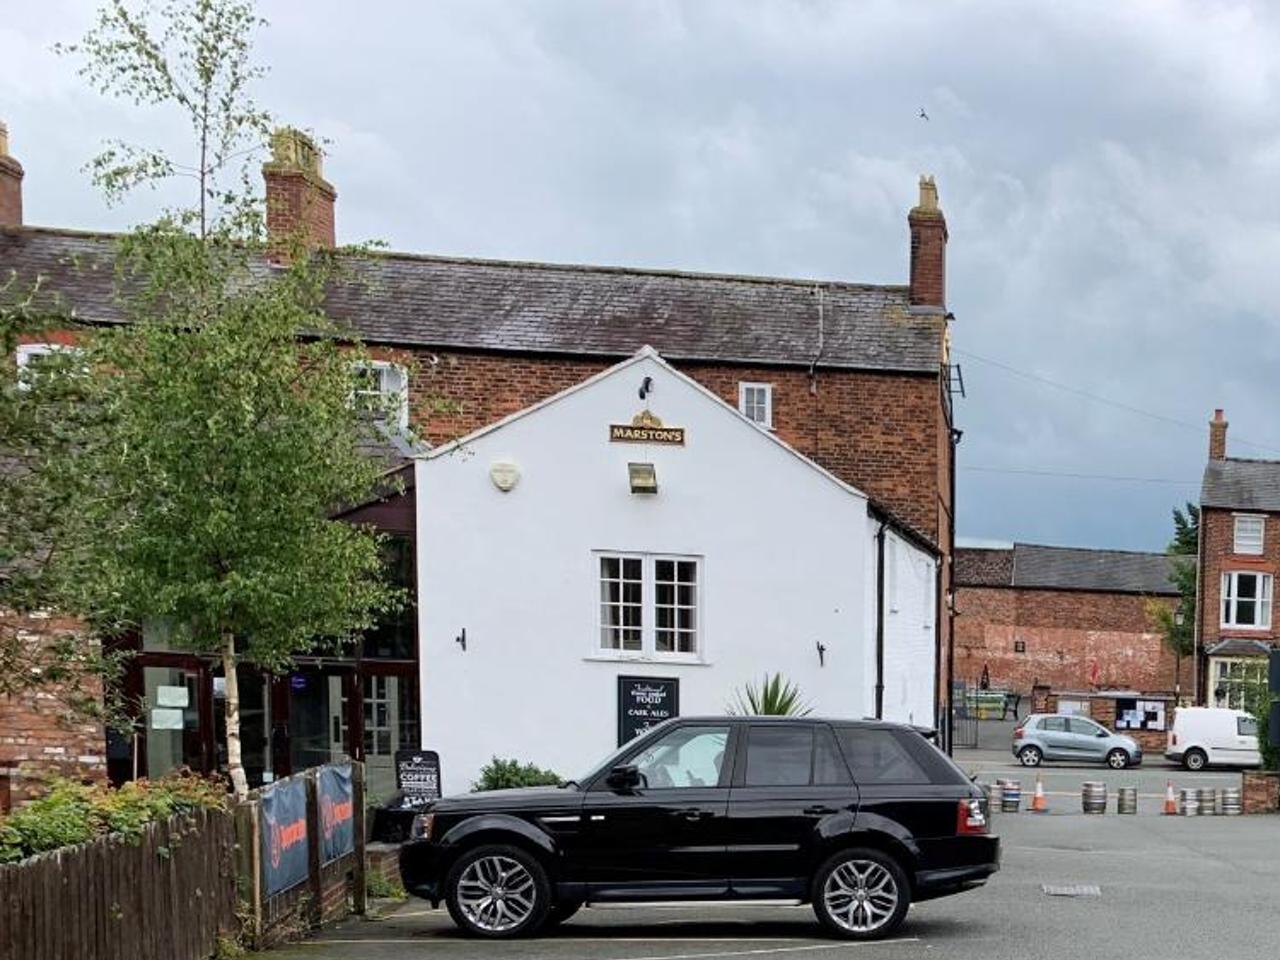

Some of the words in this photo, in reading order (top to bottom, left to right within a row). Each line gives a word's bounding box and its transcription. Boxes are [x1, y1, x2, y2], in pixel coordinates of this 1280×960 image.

[612, 428, 682, 441] MARSTON'S
[636, 696, 662, 704] FOOD
[400, 773, 438, 781] COFFEE
